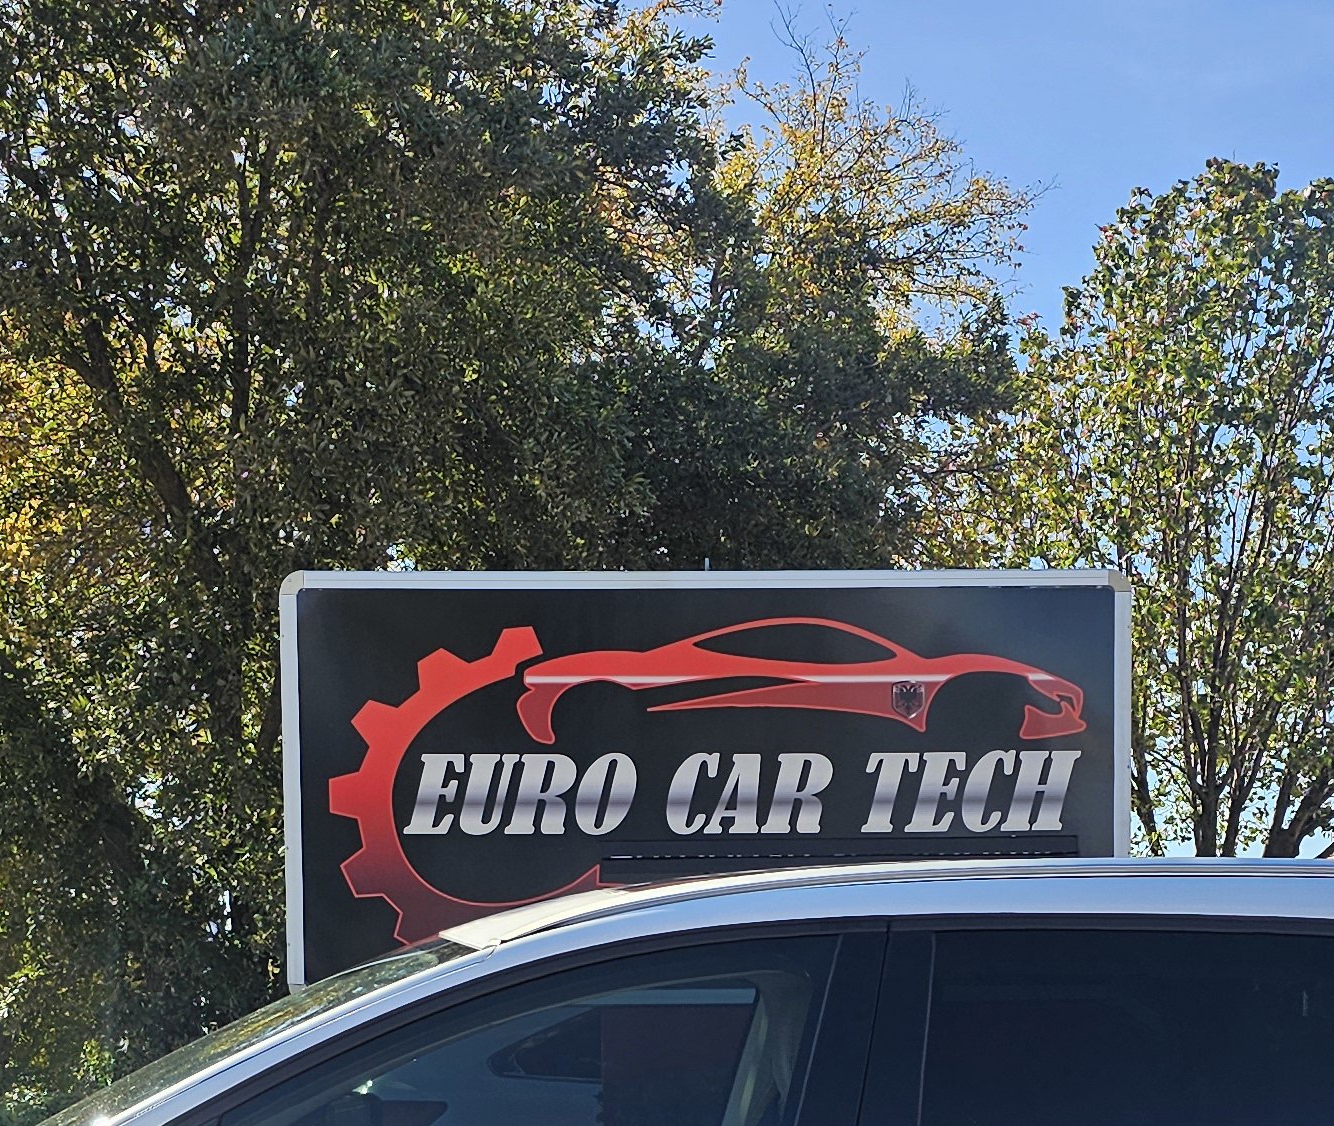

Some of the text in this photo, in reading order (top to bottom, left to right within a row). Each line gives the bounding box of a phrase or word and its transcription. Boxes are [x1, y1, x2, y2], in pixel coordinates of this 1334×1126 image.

[403, 750, 1081, 835] EURO CAR TECH
